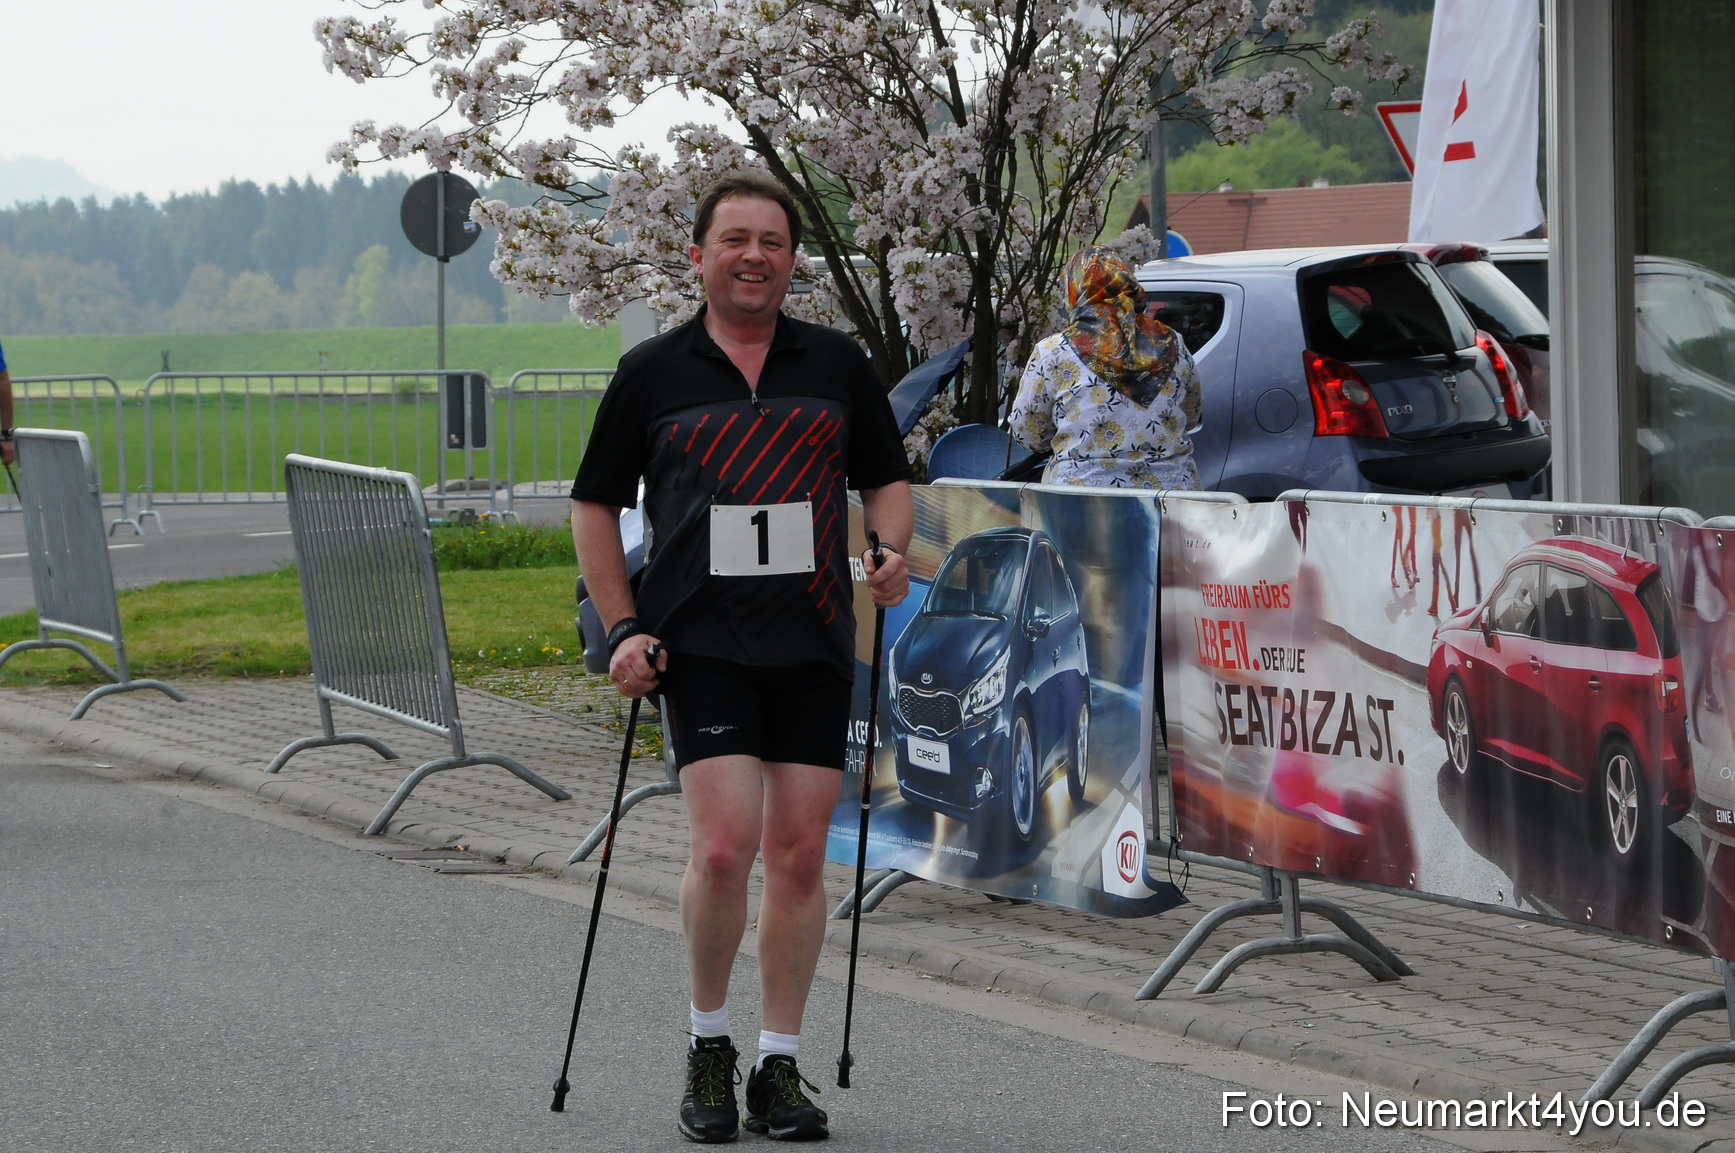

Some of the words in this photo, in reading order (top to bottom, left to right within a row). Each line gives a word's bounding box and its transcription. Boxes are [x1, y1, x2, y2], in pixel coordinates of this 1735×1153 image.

[1387, 404, 1413, 416] PIXO
[750, 510, 770, 566] 1
[1201, 583, 1251, 609] FREIRAUM
[1252, 579, 1291, 608] FÜRS
[1194, 616, 1260, 671] LEBEN.
[1260, 646, 1285, 671] DER
[1214, 681, 1279, 747] SEAT
[1278, 687, 1362, 758] BIZA
[1366, 694, 1405, 766] ST.
[1121, 842, 1137, 871] KIA
